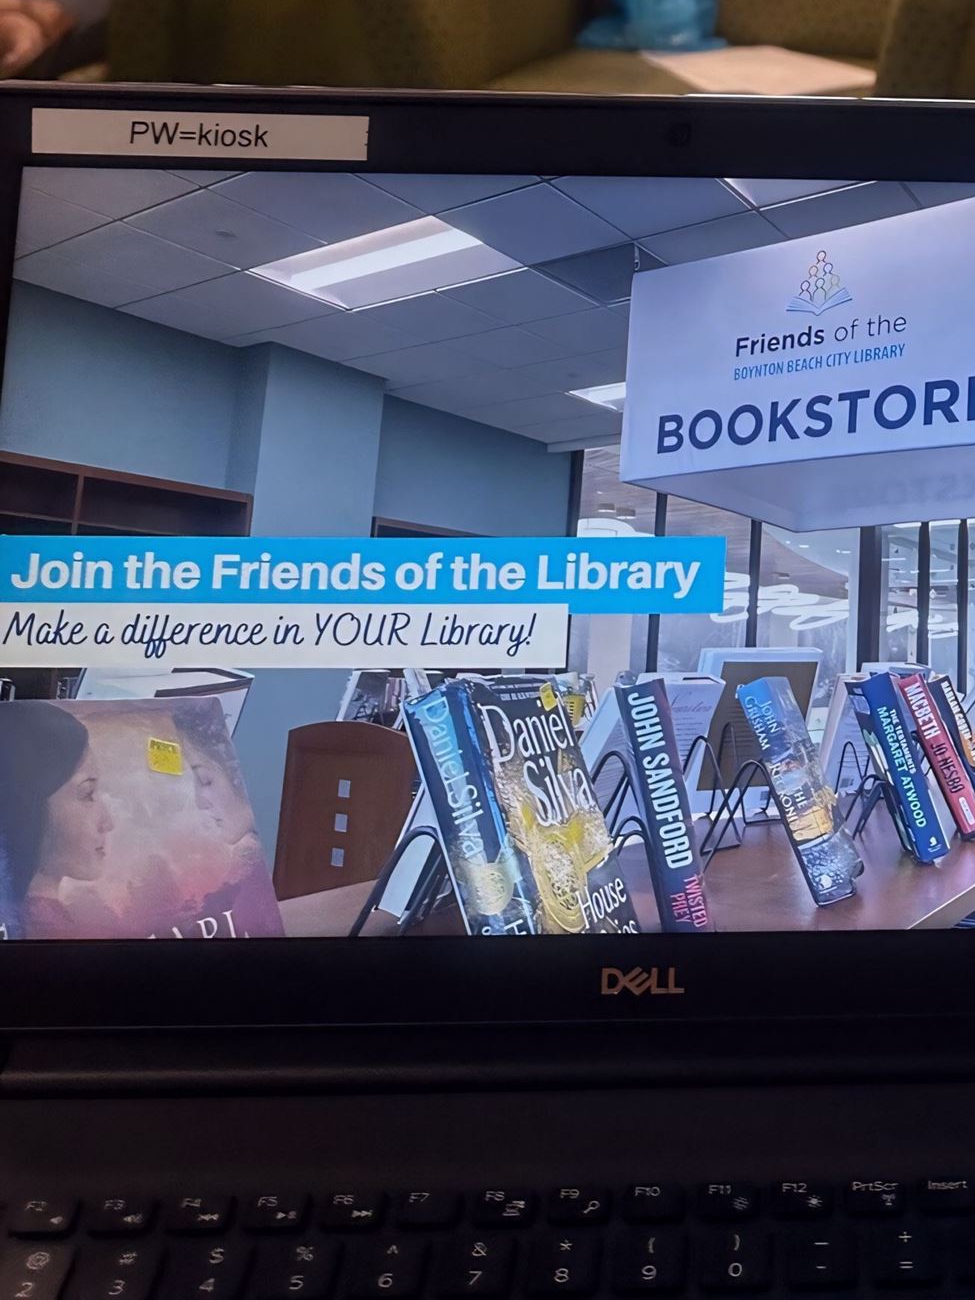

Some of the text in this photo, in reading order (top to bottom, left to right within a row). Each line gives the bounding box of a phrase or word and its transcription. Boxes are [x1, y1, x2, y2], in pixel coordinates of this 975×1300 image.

[130, 121, 268, 147] PW=kiosk
[735, 315, 907, 357] Friends of the
[734, 343, 905, 381] BOYNTON BEACH CITY LIBRARY
[11, 552, 701, 599] Join the Friends of the Library
[3, 609, 537, 659] Make a difference in YOUR Library!
[761, 700, 782, 733] JOHN
[904, 682, 941, 739] MACBETH
[477, 691, 574, 763] Daniel
[627, 692, 664, 751] JOHN
[745, 696, 770, 750] GRISHAM
[877, 706, 927, 828] MARGARET ATWOOD
[423, 697, 487, 865] Daniel Silva
[523, 756, 594, 828] Silva
[643, 753, 693, 869] SANDFORD
[576, 878, 627, 929] House
[684, 873, 708, 927] TWISTED
[601, 966, 685, 995] DELL
[634, 1186, 661, 1197] F10
[708, 1184, 731, 1195] F11
[782, 1182, 808, 1193] F12
[852, 1180, 899, 1192] PrtScr
[927, 1178, 968, 1190] Insert
[257, 1196, 278, 1207] F5
[333, 1194, 354, 1205] F6
[409, 1192, 430, 1203] F7
[559, 1188, 580, 1199] F9
[898, 1231, 912, 1243] +
[209, 1248, 225, 1264] $
[471, 1242, 488, 1257] &
[26, 1252, 50, 1270] @
[378, 1272, 394, 1288] 6
[468, 1270, 482, 1286] 7
[554, 1267, 570, 1282] 8
[641, 1265, 657, 1280] 9
[15, 1282, 33, 1298] 2
[109, 1280, 125, 1295] 3
[198, 1278, 215, 1292] 4
[289, 1275, 305, 1291] 5
